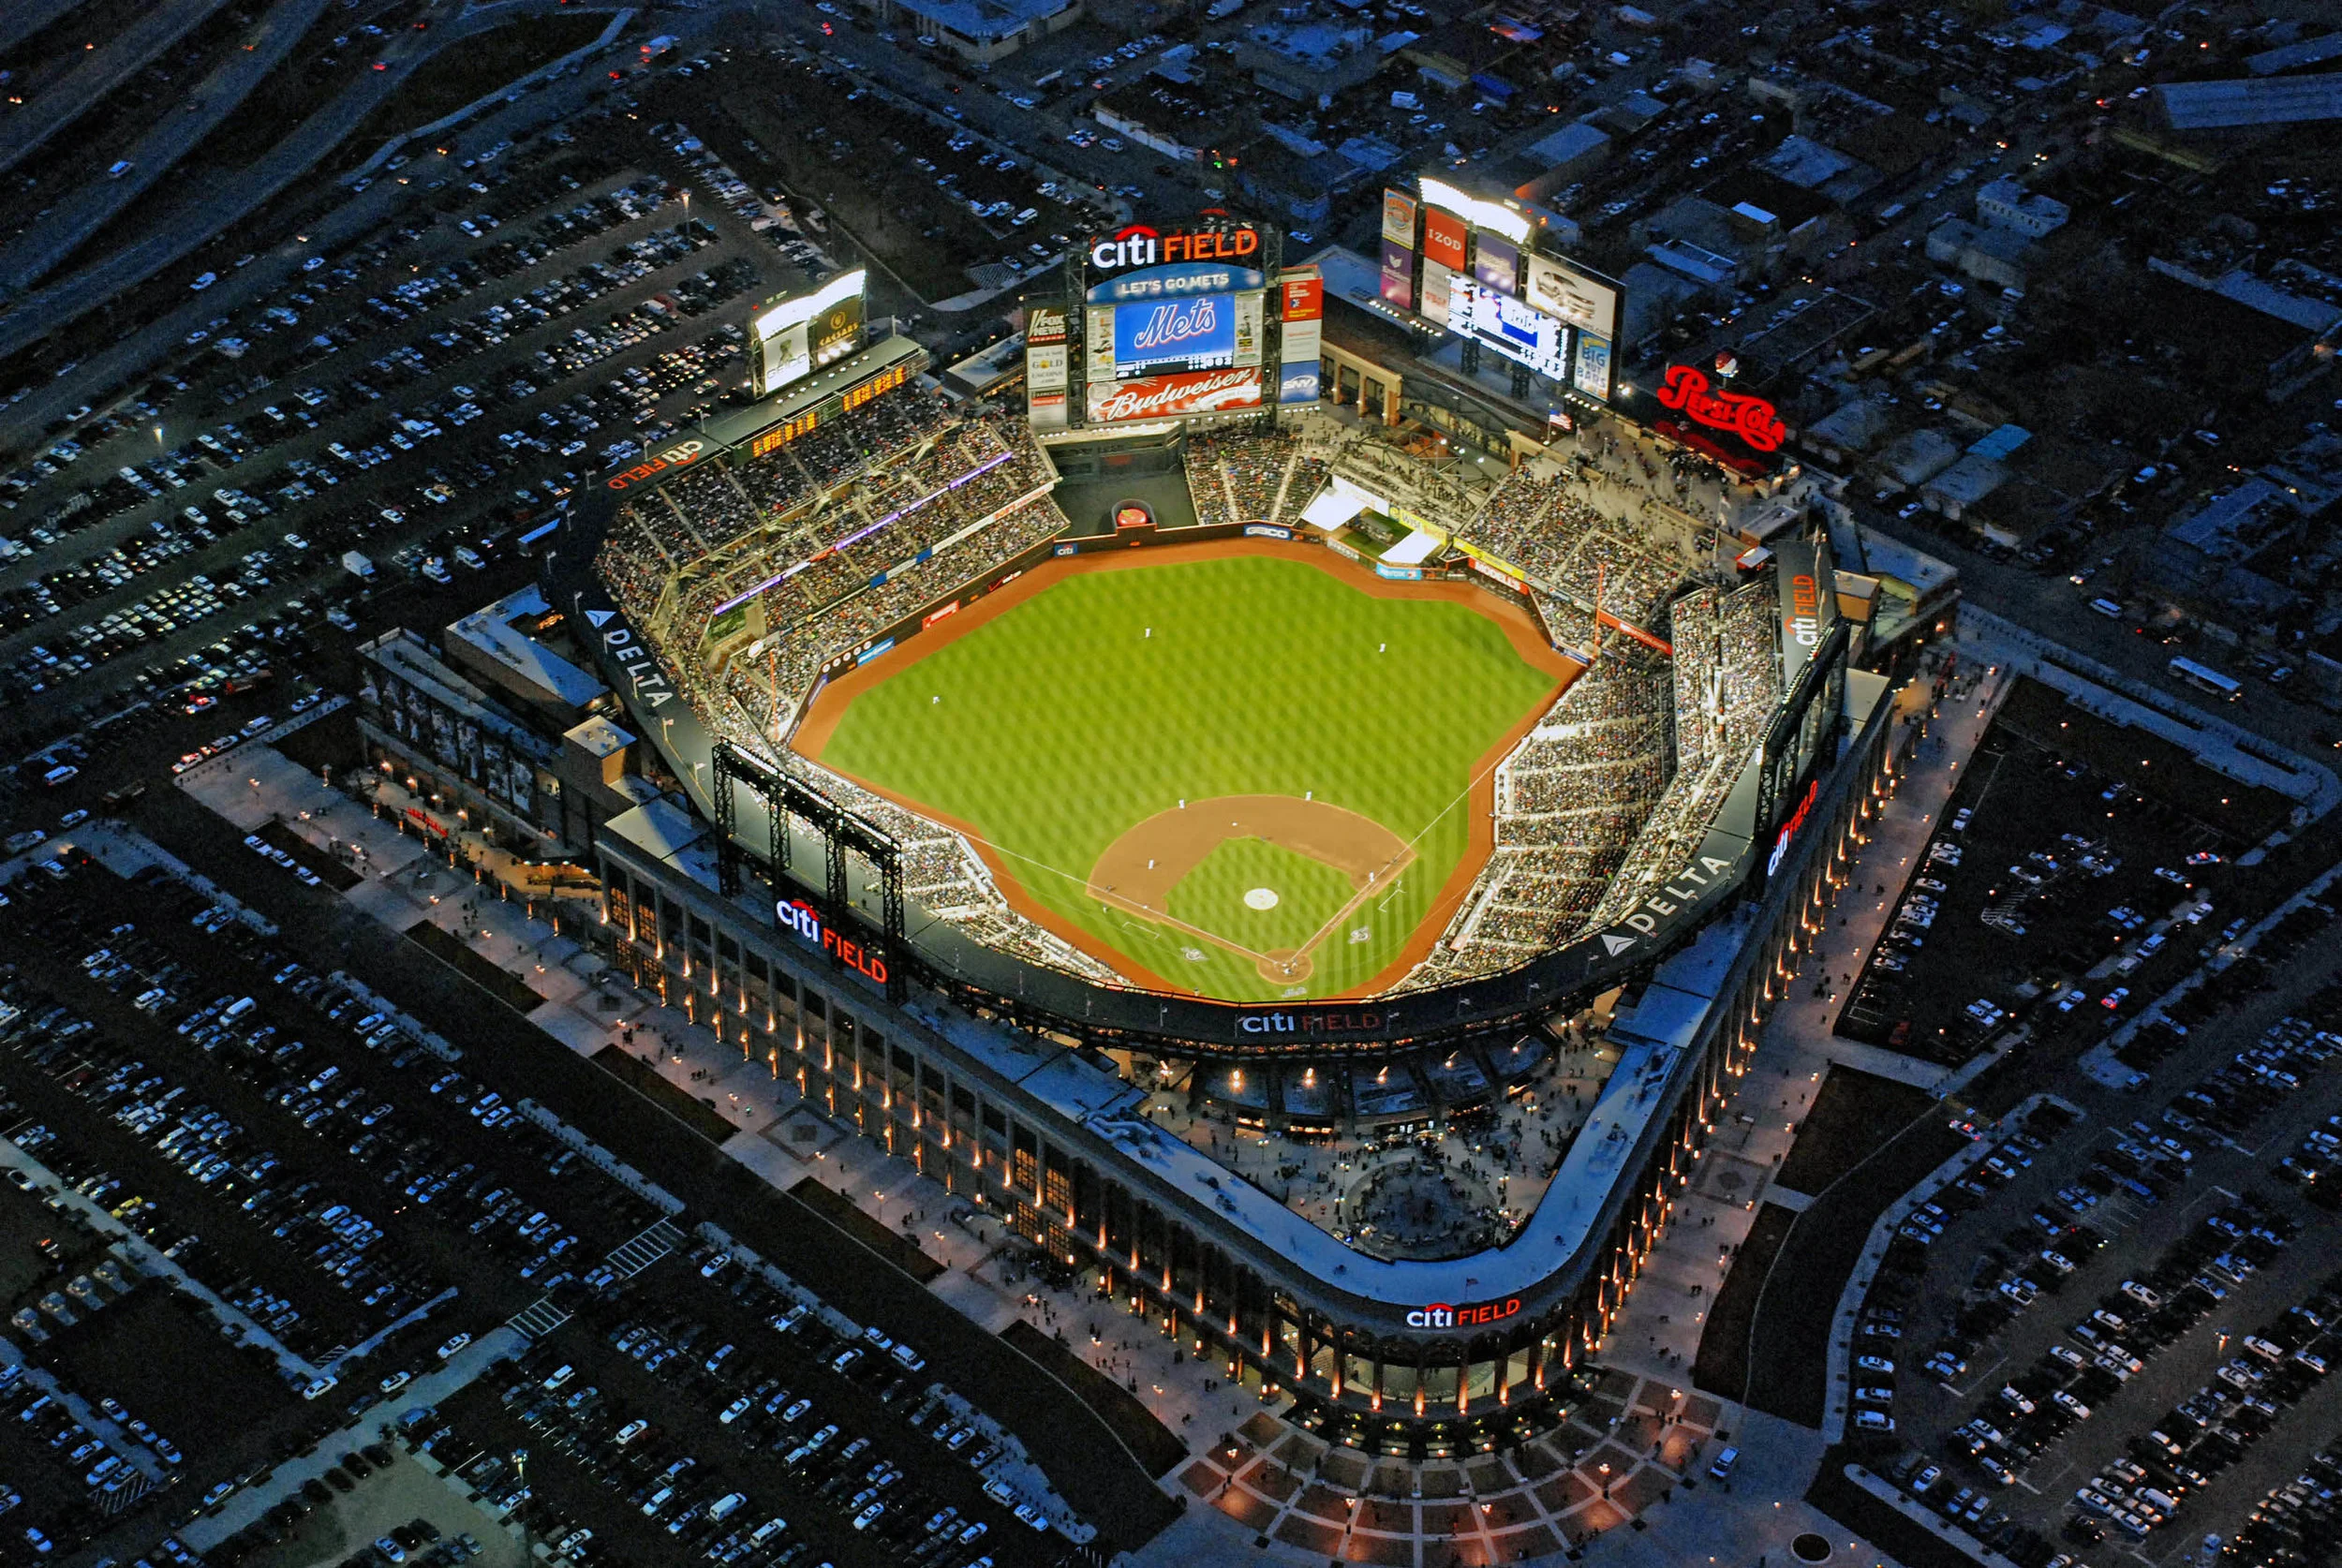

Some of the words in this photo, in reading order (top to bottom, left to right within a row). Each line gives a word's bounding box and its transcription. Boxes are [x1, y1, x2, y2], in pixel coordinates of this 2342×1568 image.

[1092, 232, 1155, 269] citi
[1164, 229, 1258, 262] FIELD
[1428, 229, 1461, 251] IZOD
[1121, 280, 1162, 294] LET'S
[1165, 278, 1185, 289] GO
[1190, 274, 1229, 287] METS
[1032, 325, 1066, 336] NEWS
[1041, 315, 1064, 326] FOX
[1134, 298, 1216, 349] Mets
[819, 322, 859, 347] CAESARS
[1582, 348, 1606, 367] BIG
[1100, 368, 1252, 422] Budweiser
[1282, 378, 1312, 390] SNY
[608, 458, 668, 489] FIELD
[1792, 574, 1816, 616] FIELD
[608, 629, 674, 707] DELTA
[1625, 855, 1731, 934] DELTA
[823, 927, 887, 984] FIELD
[1302, 1013, 1380, 1030] FIELD
[1458, 1299, 1520, 1326] FIELD
